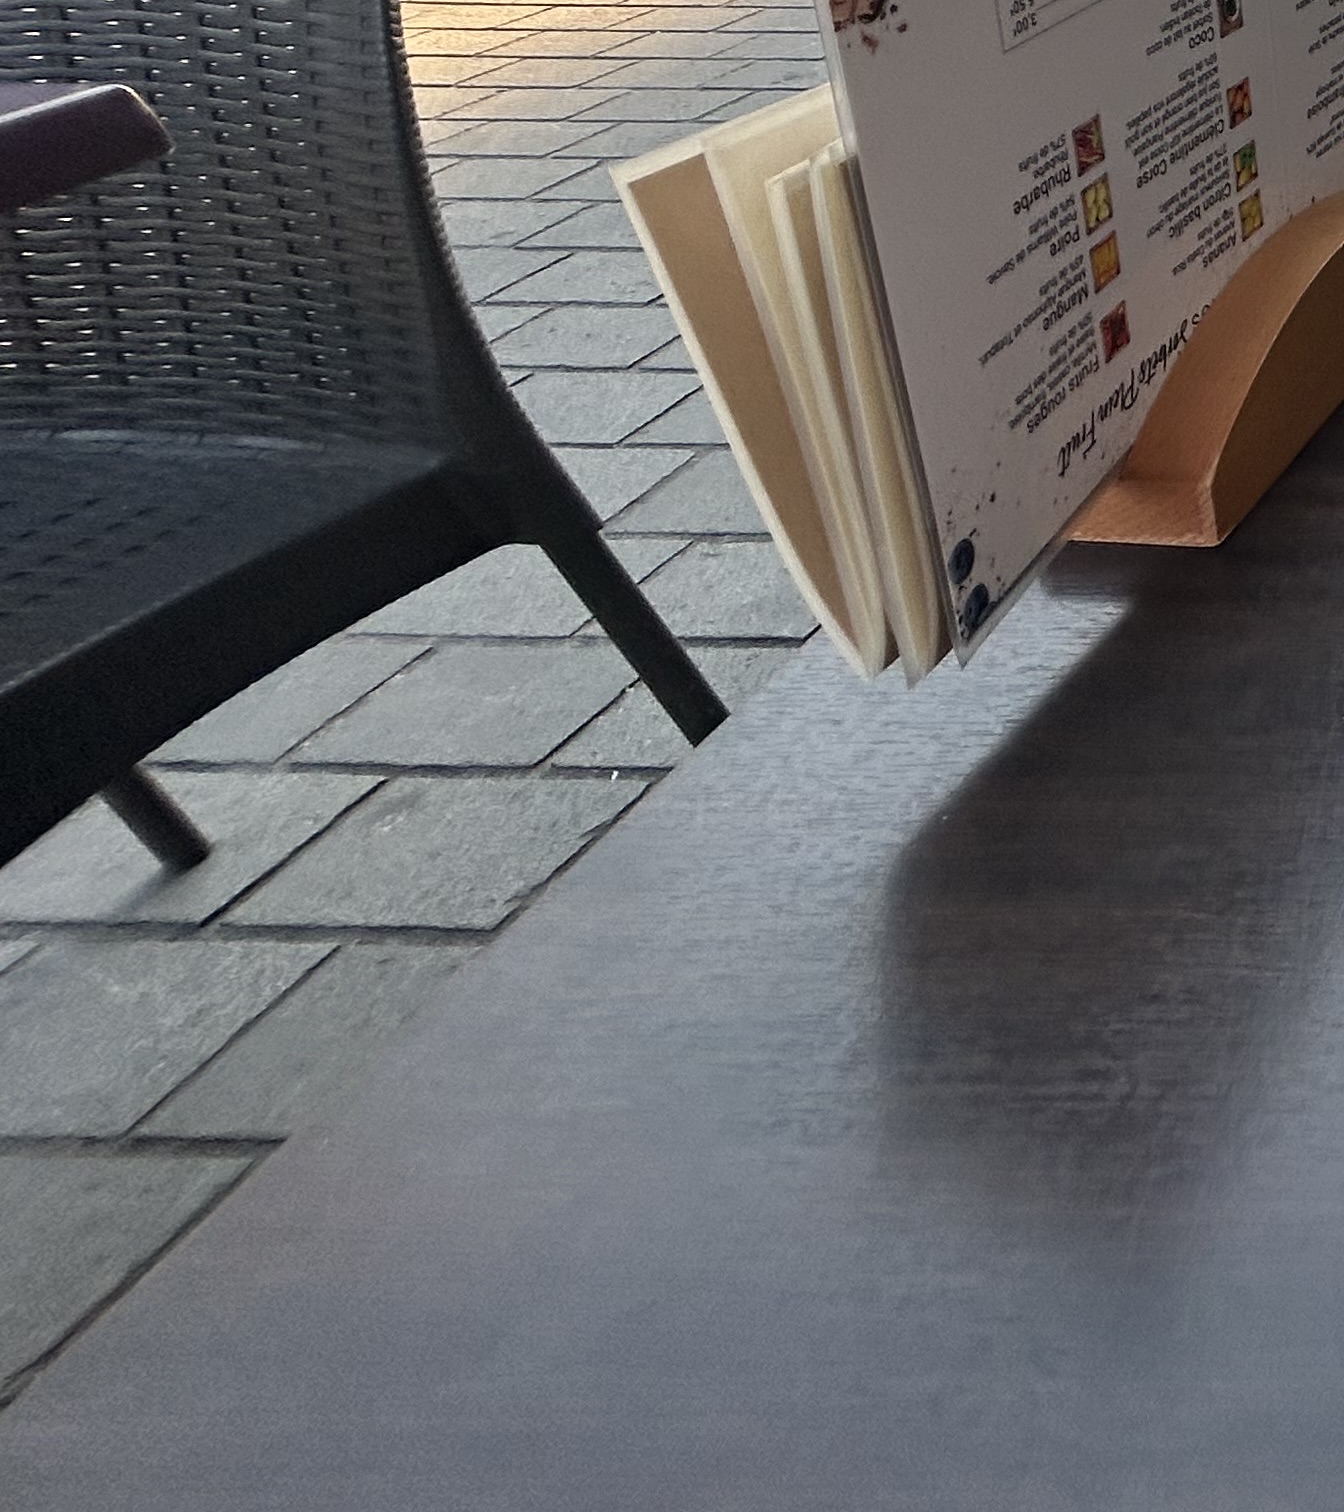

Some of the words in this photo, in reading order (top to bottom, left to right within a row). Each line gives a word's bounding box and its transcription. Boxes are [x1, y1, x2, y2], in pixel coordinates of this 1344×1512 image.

[1188, 26, 1215, 49] Coco
[1169, 119, 1224, 164] Clémentine
[1013, 165, 1071, 215] Rhubarbe
[1136, 158, 1167, 189] Corse
[1202, 182, 1232, 211] Citron
[1049, 225, 1080, 257] Poire
[1168, 205, 1201, 238] basilic
[1202, 231, 1237, 268] Ananas
[1042, 283, 1089, 331] Mangue
[1138, 319, 1188, 384] Sorbets
[1068, 354, 1100, 392] Fruits
[1026, 387, 1066, 433] rouges
[1097, 369, 1139, 421] Plein
[1057, 411, 1096, 477] Fruit
